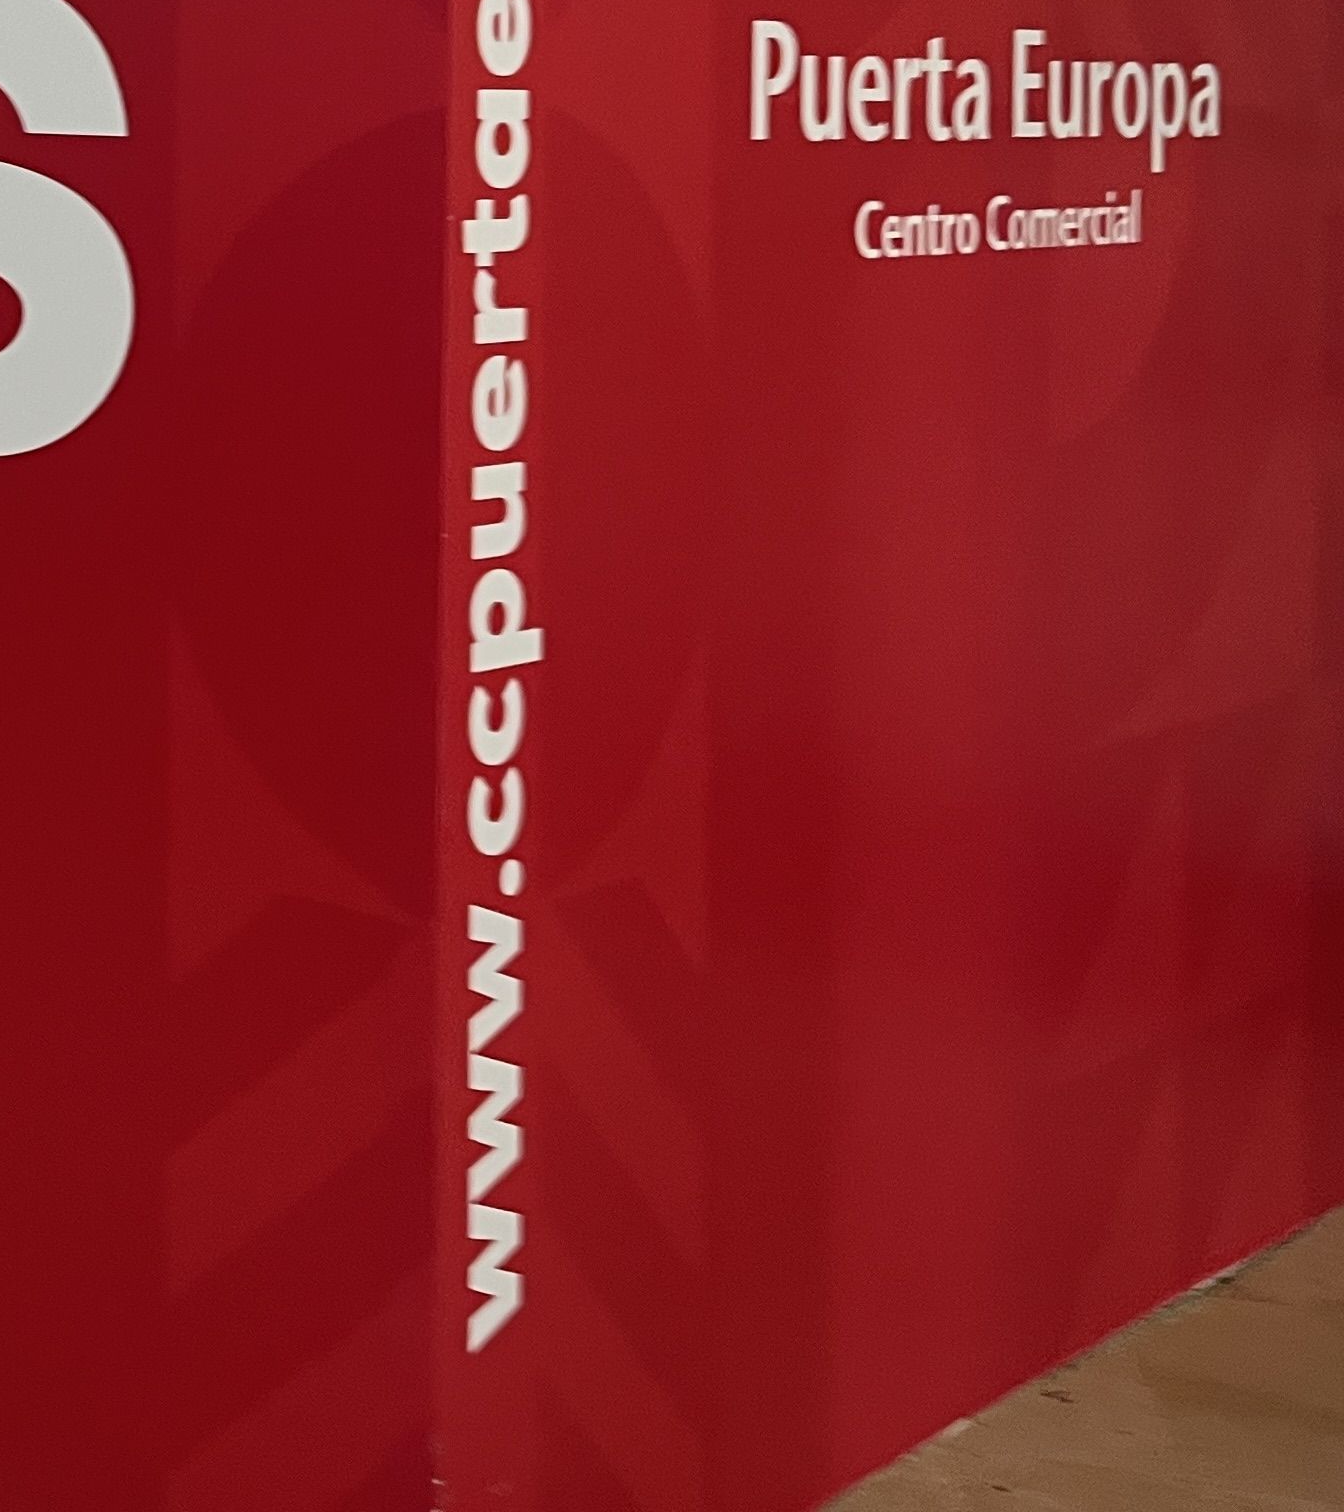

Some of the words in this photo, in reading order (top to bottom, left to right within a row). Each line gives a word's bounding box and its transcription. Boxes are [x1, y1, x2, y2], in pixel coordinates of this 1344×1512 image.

[749, 19, 992, 143] Puerta
[1011, 27, 1221, 174] Europa
[853, 199, 980, 260] Centro
[985, 189, 1142, 252] Comercial
